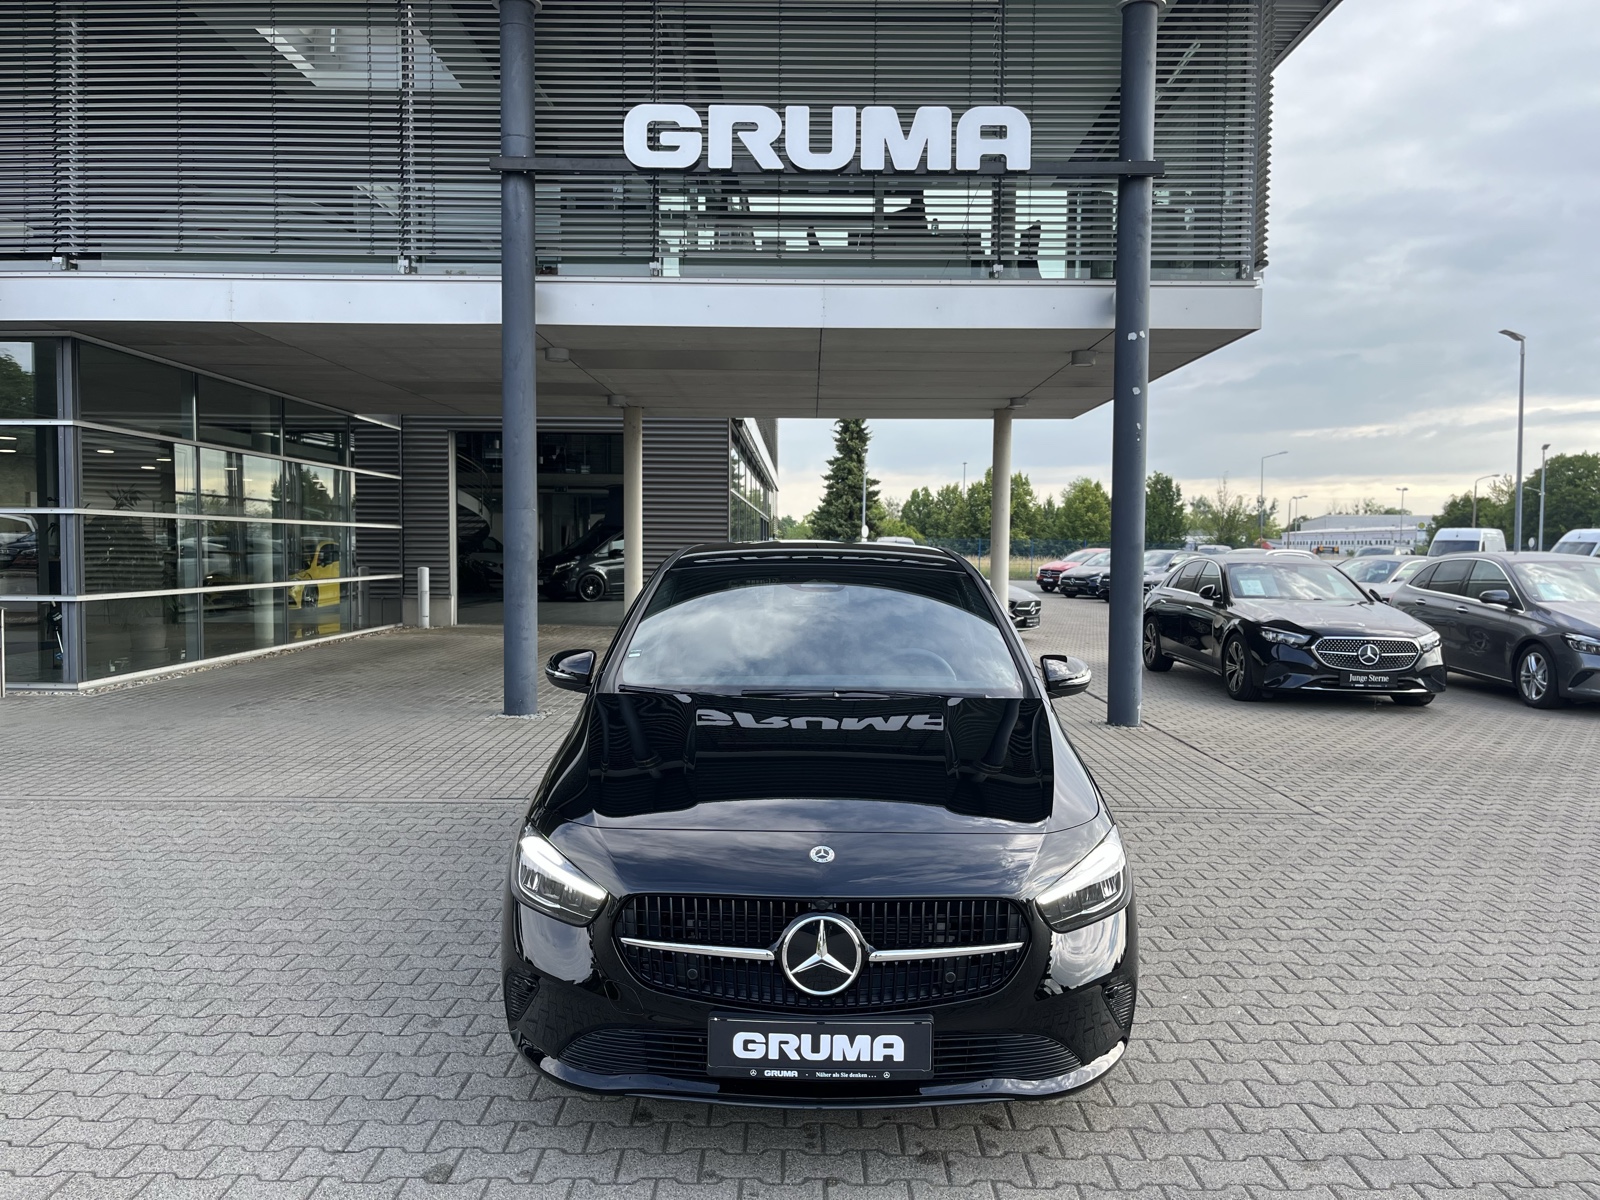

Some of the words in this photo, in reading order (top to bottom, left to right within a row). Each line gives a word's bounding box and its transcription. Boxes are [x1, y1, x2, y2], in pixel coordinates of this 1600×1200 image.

[623, 103, 1031, 170] GRUMA
[1349, 673, 1367, 683] Junge
[1368, 674, 1389, 682] Sterne
[733, 1032, 904, 1062] GRUMA
